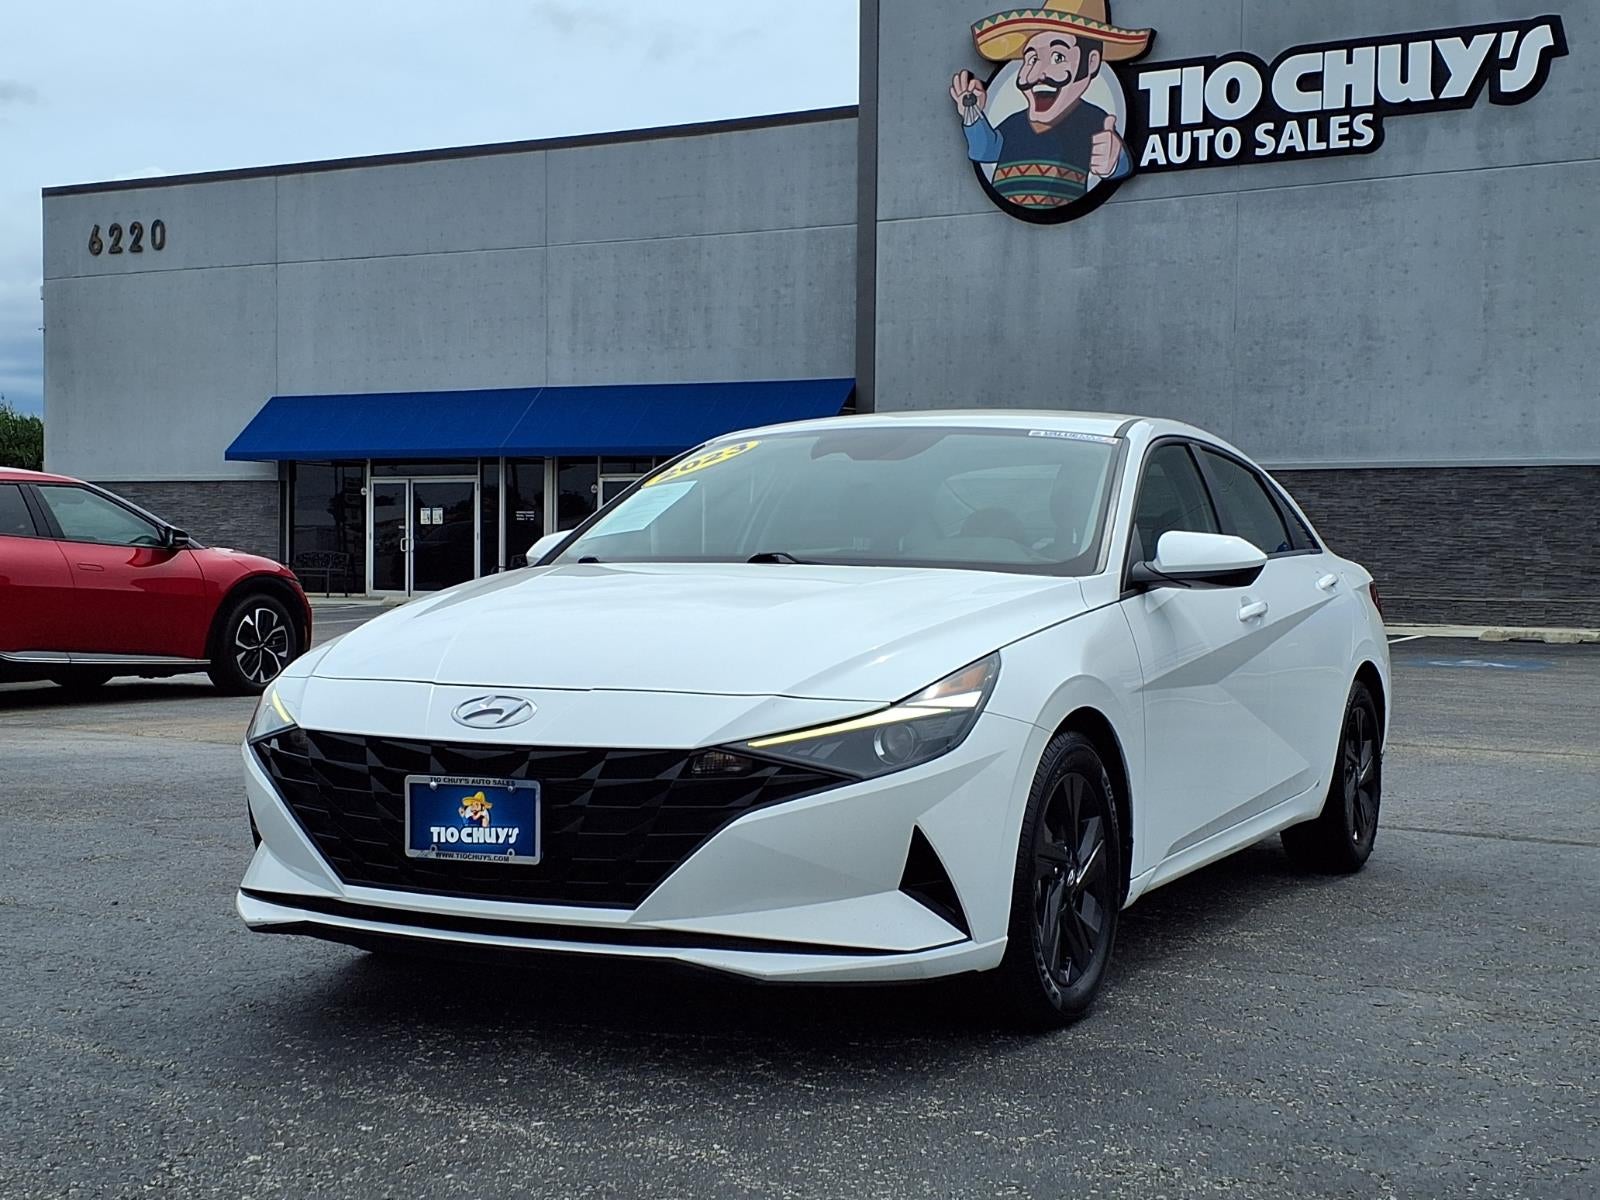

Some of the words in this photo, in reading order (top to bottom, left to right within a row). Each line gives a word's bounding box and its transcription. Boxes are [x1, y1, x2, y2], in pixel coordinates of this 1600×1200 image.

[1138, 60, 1263, 128] TIO
[1271, 24, 1555, 113] CHUY'S
[1140, 127, 1242, 167] AUTO
[1255, 113, 1375, 157] SALES
[88, 219, 166, 257] 6220
[657, 443, 749, 481] 2023
[443, 777, 470, 785] CHUY'S
[471, 778, 491, 786] AUTO
[430, 826, 459, 843] TIO
[460, 827, 519, 844] CHUY'S
[435, 852, 510, 862] WWW.TIOCHUYS.COM
